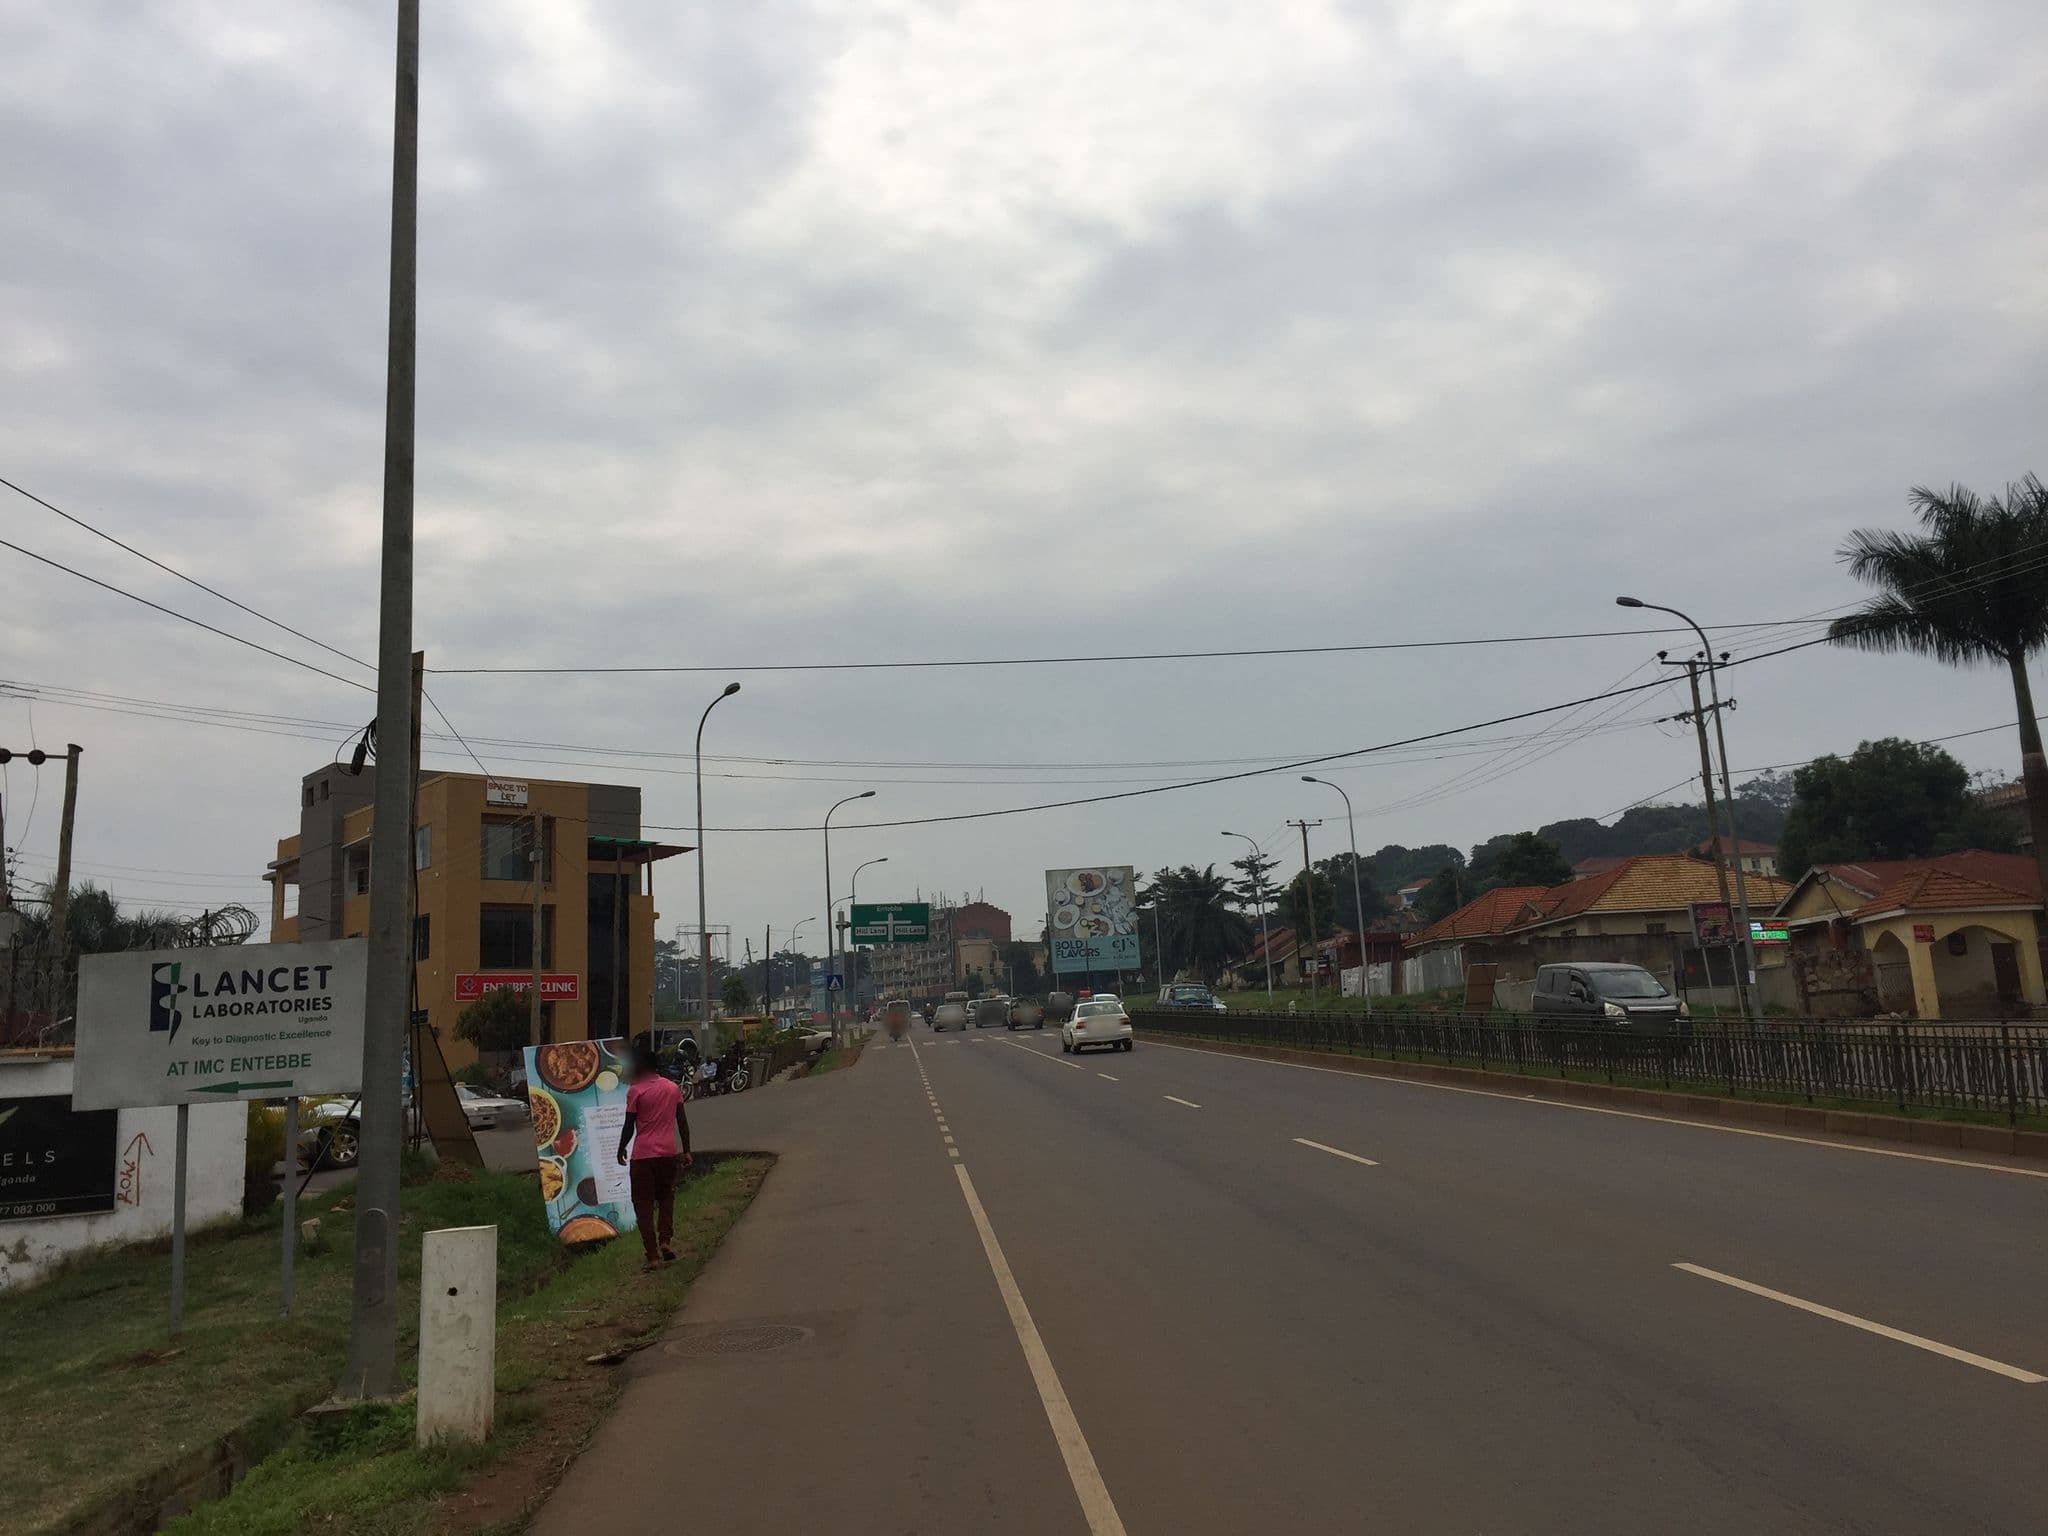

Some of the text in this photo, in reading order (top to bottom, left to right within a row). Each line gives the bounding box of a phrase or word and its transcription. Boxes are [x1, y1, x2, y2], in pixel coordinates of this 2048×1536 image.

[488, 783, 527, 793] SPACE TO
[501, 793, 516, 802] LET
[1056, 940, 1083, 950] BOLD
[1056, 948, 1100, 959] FLAVORS
[193, 965, 333, 998] LANCET
[540, 982, 577, 993] CLINIC
[193, 996, 333, 1019] LABORATORIES
[298, 1015, 328, 1024] Uganda
[192, 1028, 332, 1047] Key to Diagnostic Excellence
[167, 1053, 312, 1076] AT IMC ENTEBBE
[0, 1174, 36, 1187] ganda
[13, 1204, 33, 1215] 082
[36, 1202, 56, 1213] 000
